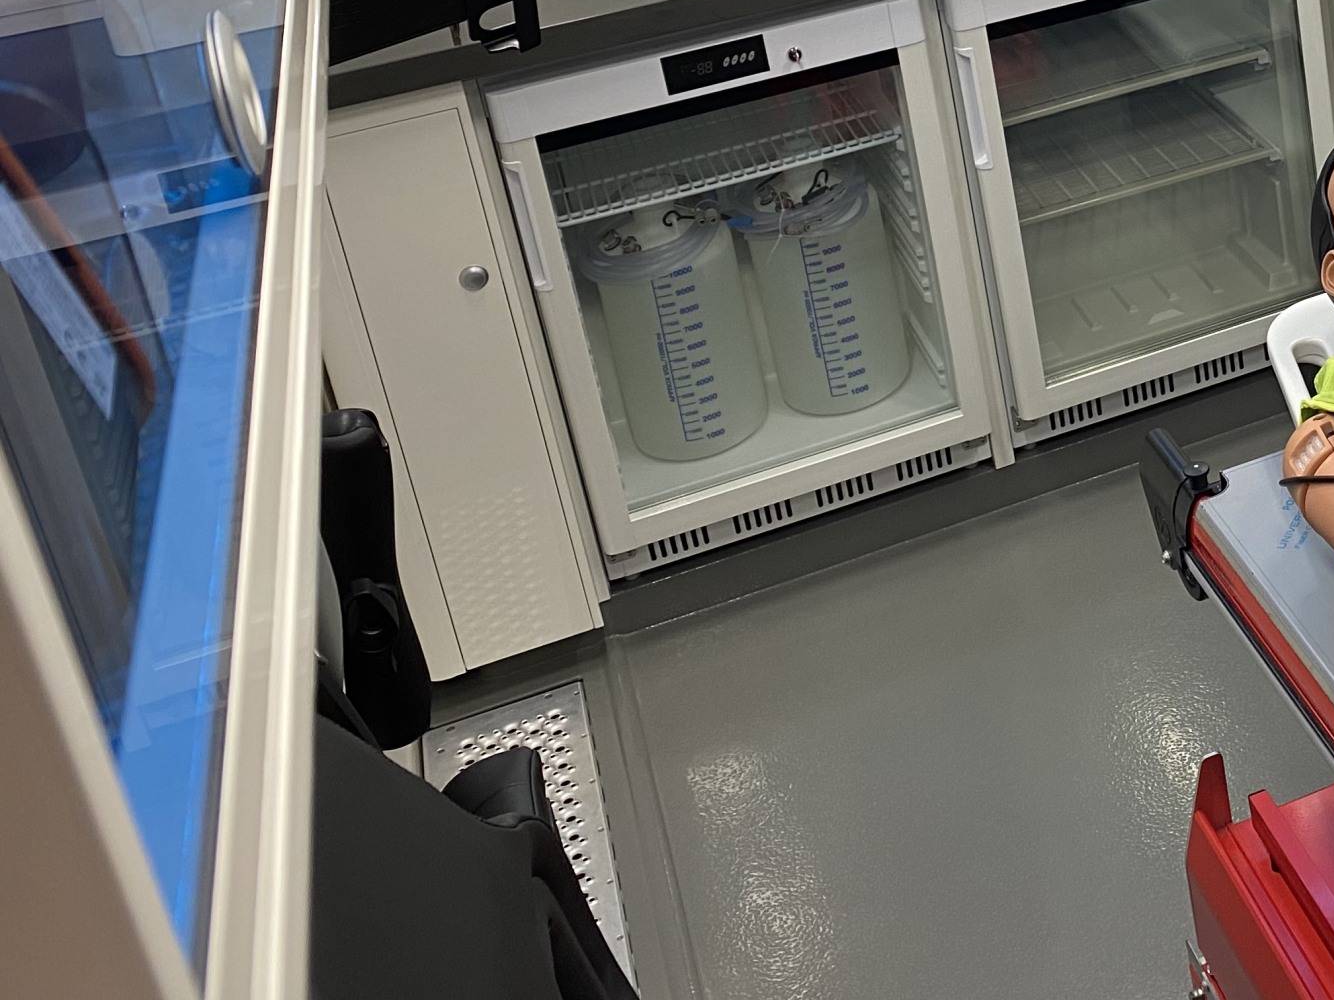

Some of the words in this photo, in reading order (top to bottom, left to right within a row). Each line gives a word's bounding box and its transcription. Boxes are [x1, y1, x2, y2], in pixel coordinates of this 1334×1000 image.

[823, 245, 841, 255] 9000
[669, 266, 692, 278] 10000
[826, 263, 845, 273] 8000
[676, 285, 695, 296] 9000
[830, 281, 848, 291] 7000
[680, 303, 699, 314] 8000
[833, 299, 852, 308] 6000
[837, 316, 855, 326] 5000
[684, 322, 703, 332] 7000
[841, 333, 858, 343] 4000
[687, 340, 706, 351] 6000
[844, 351, 862, 361] 3000
[691, 358, 710, 369] 5000
[848, 368, 865, 378] 2000
[695, 375, 714, 386] 4000
[852, 385, 869, 395] 1000
[699, 393, 718, 404] 3000
[702, 411, 721, 422] 2000
[706, 428, 725, 439] 1000
